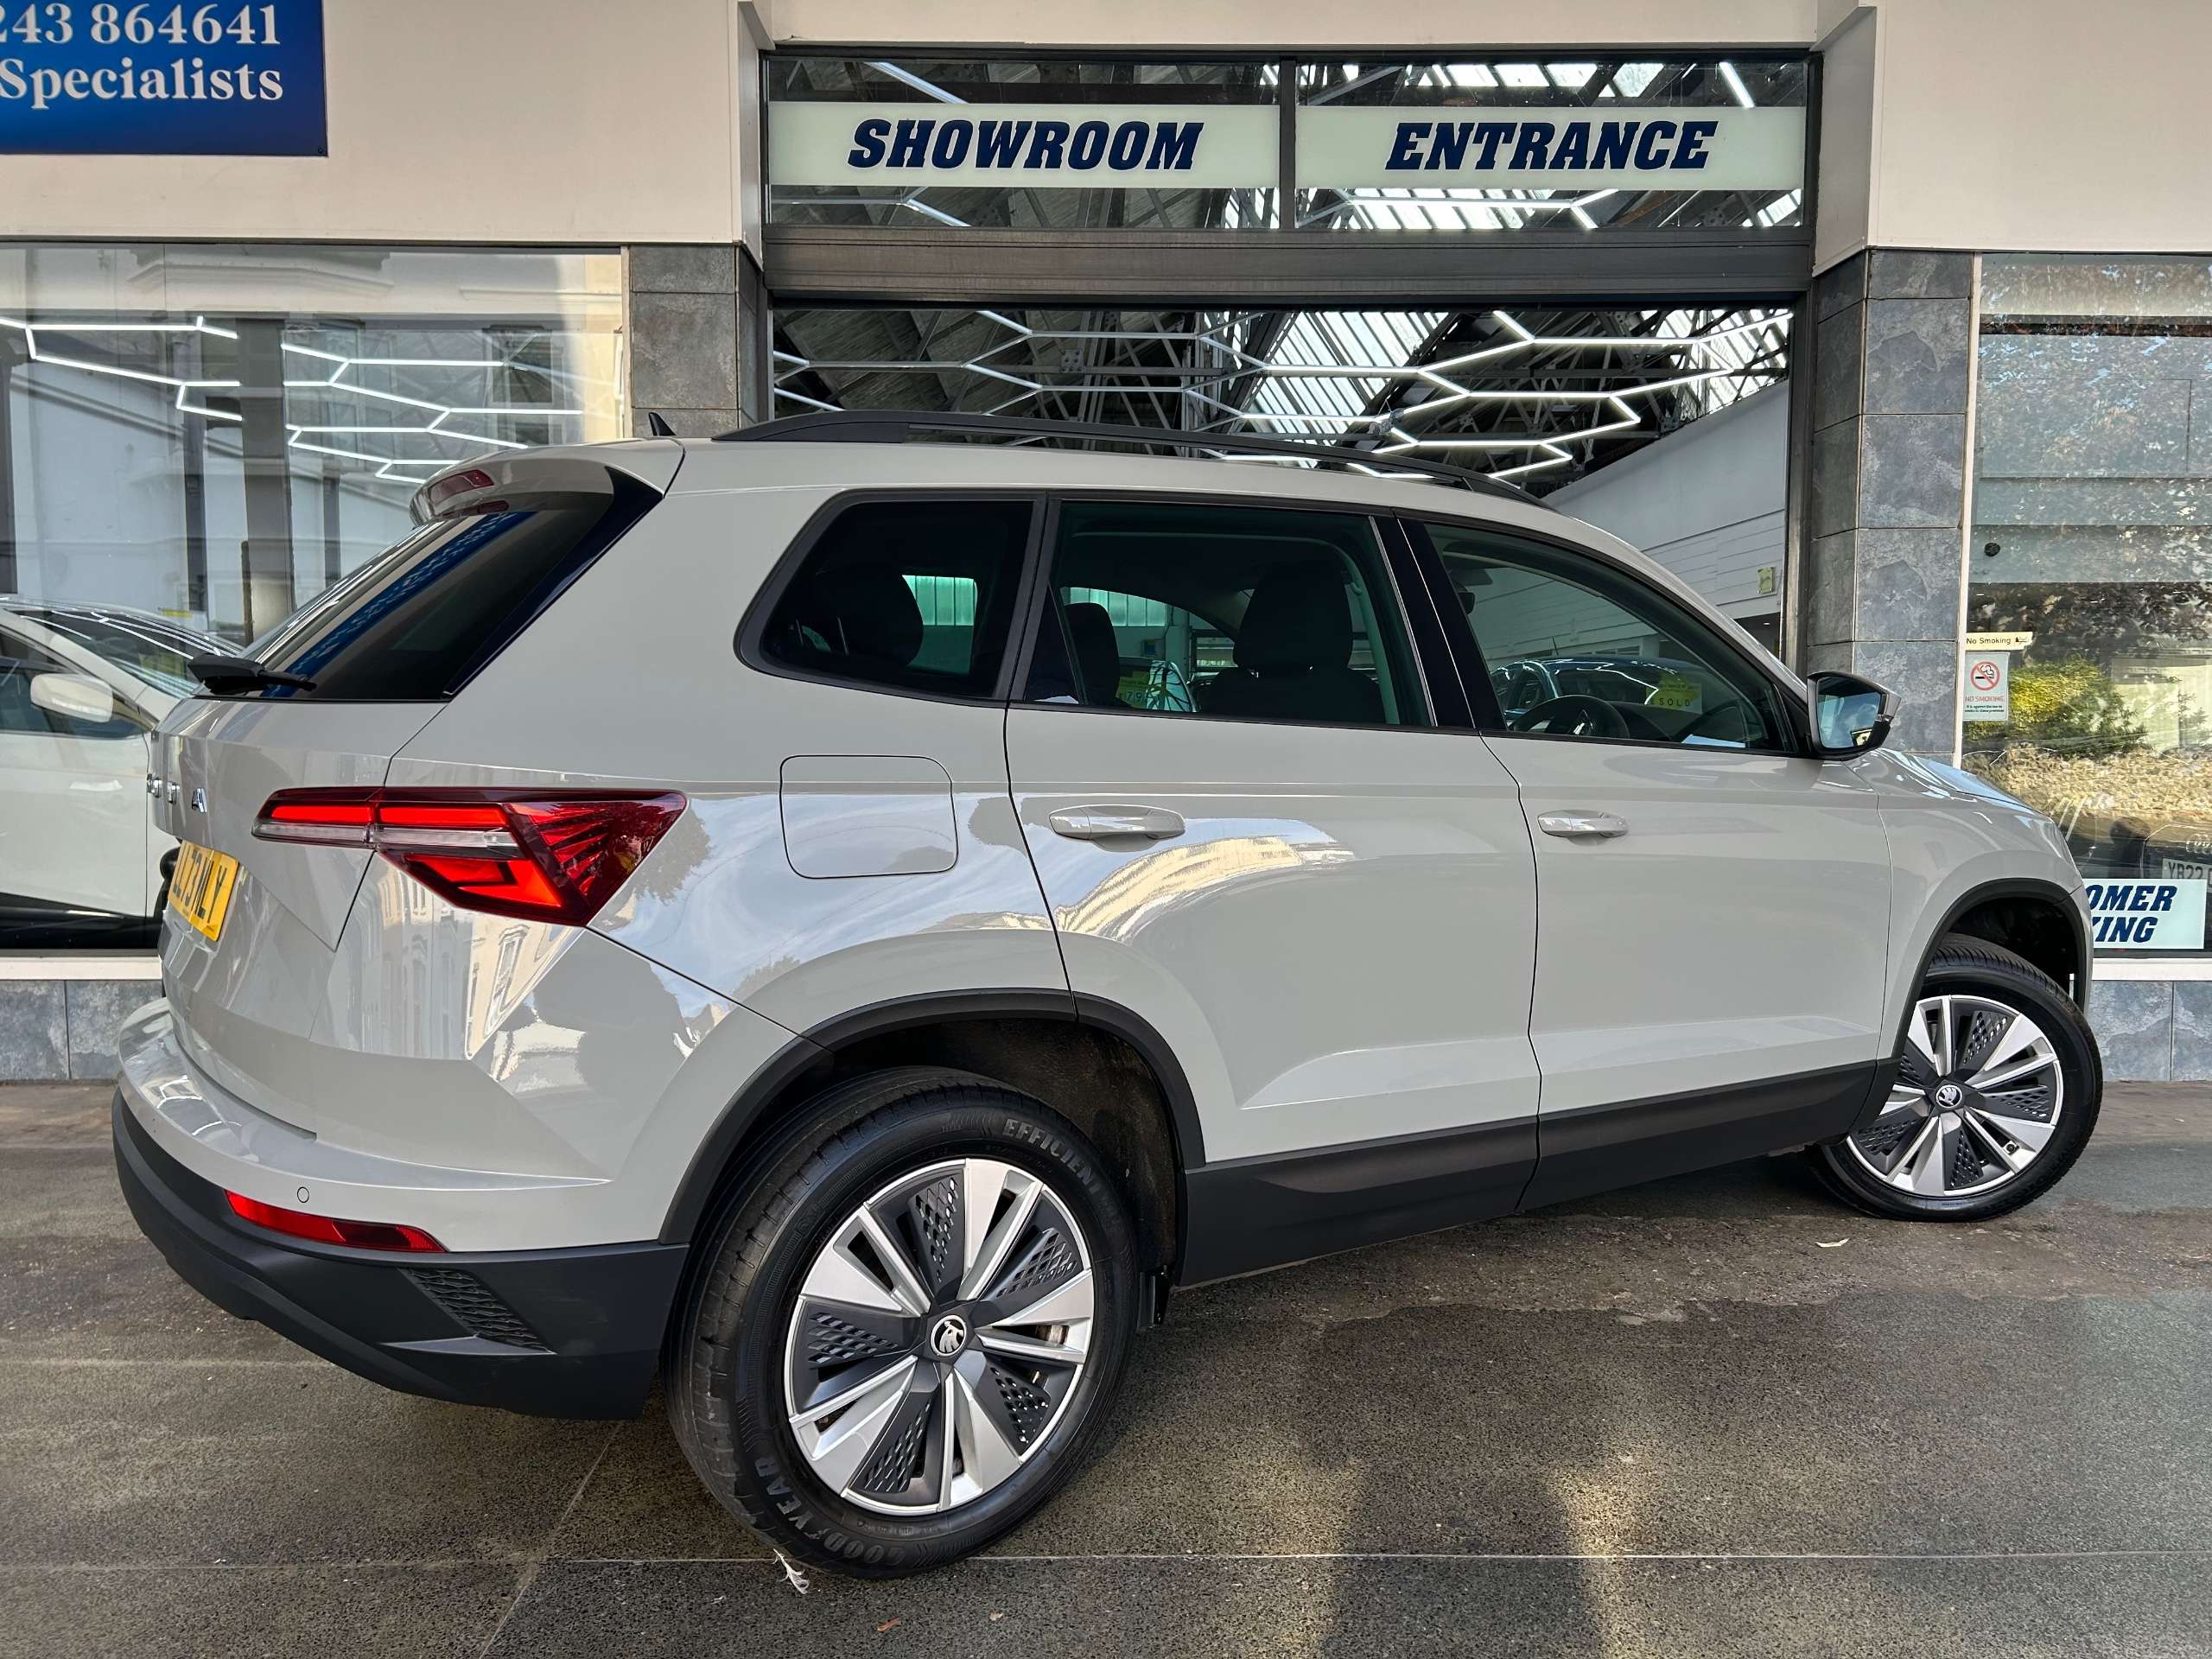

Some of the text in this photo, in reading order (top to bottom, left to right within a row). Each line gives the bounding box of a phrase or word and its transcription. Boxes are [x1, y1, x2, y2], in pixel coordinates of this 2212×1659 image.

[0, 3, 281, 44] 43 864641
[0, 57, 283, 110] Specialists
[847, 118, 1719, 170] SHOWROOM ENTRANCE
[1979, 637, 2012, 645] Smoking
